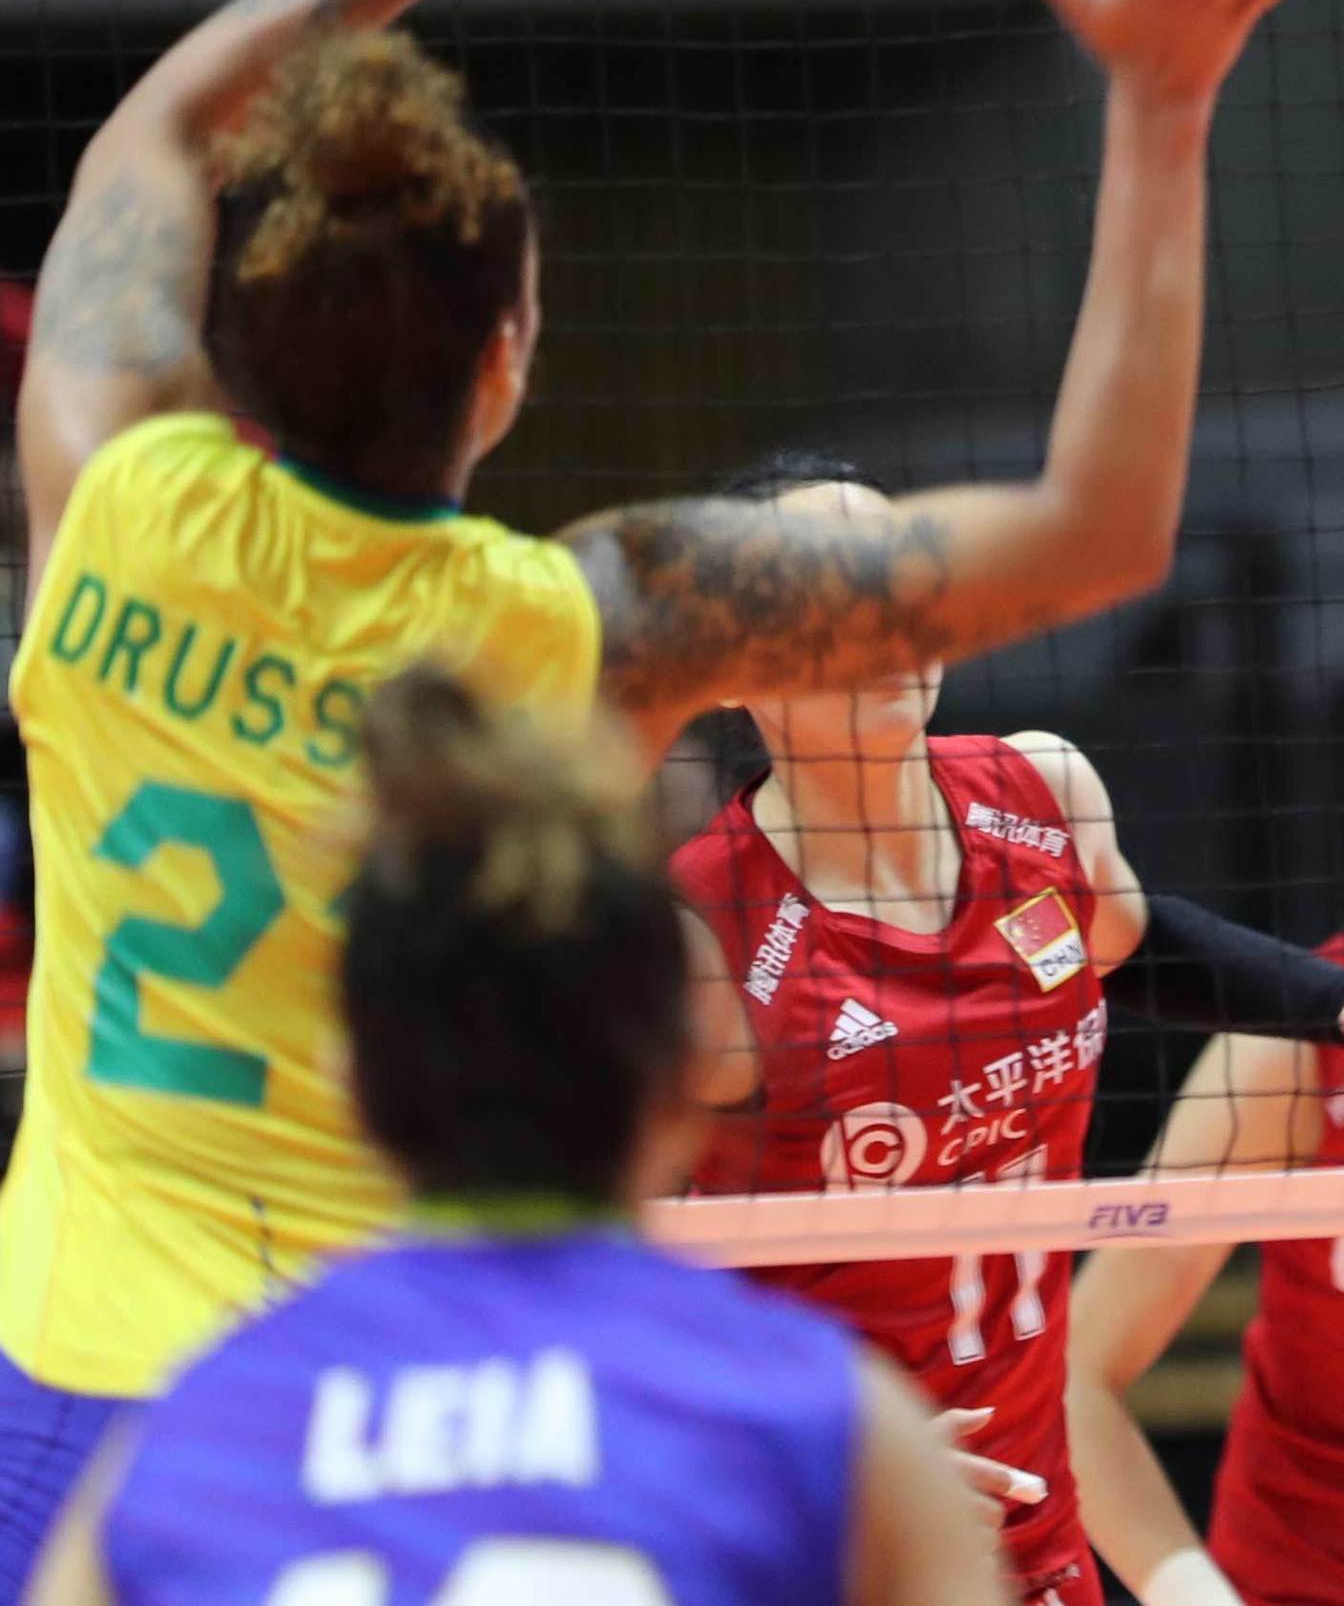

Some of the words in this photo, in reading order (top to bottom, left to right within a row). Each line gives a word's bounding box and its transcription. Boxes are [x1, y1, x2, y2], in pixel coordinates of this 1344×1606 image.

[87, 776, 287, 1110] 2
[826, 1020, 899, 1061] adidas
[936, 1107, 1028, 1167] CPIC
[1088, 1201, 1169, 1229] FIVB
